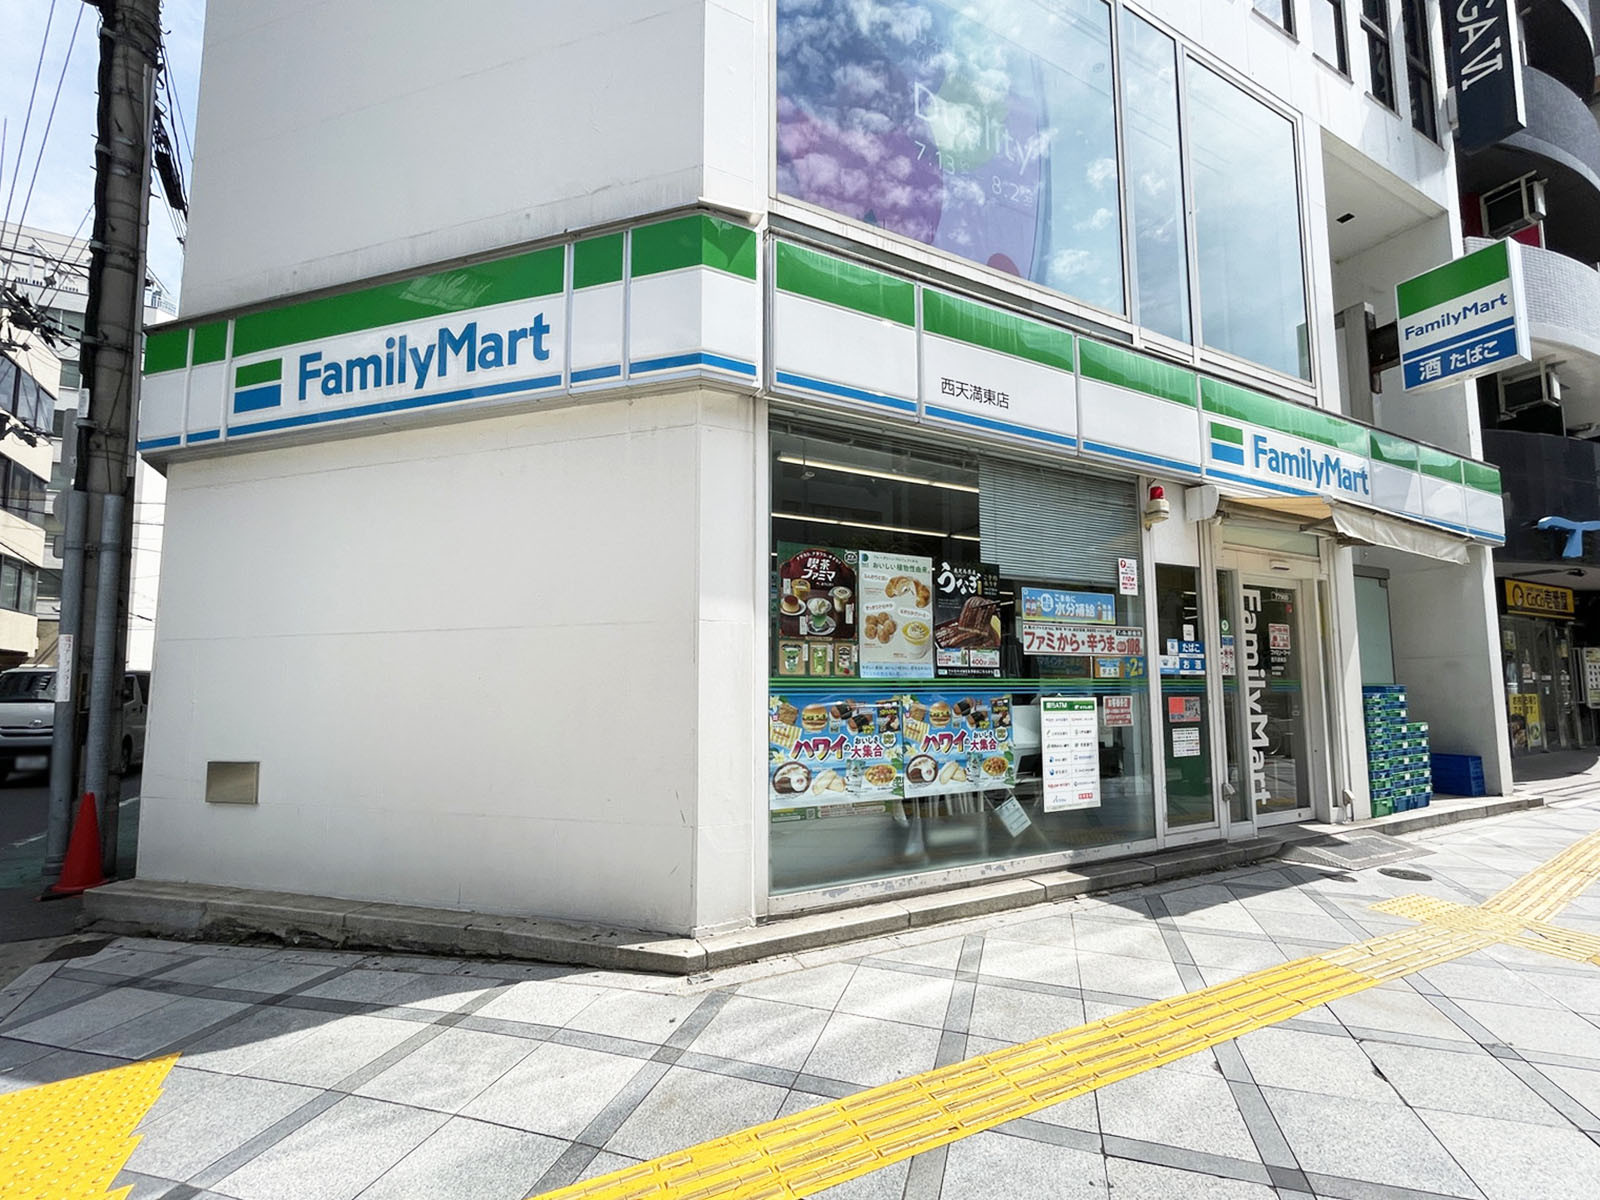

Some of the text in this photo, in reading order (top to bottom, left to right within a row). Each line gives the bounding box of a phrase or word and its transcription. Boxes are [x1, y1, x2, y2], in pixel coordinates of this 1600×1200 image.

[1405, 293, 1508, 340] FamilyMart
[299, 312, 551, 401] FamilyMart
[1419, 340, 1500, 381] 酒 たばこ
[940, 376, 1010, 410] 西天満東店
[1253, 434, 1370, 496] FamilyMart
[801, 568, 837, 581] ファミマ
[807, 557, 831, 570] 喫茶
[937, 561, 982, 595] うなぎ
[1055, 602, 1095, 617] 水分補給
[1242, 588, 1272, 806] FamilyMart
[790, 735, 851, 760] ハワイの
[850, 744, 884, 758] 大集合
[920, 730, 971, 754] ハワイの
[970, 738, 997, 751] 大集合
